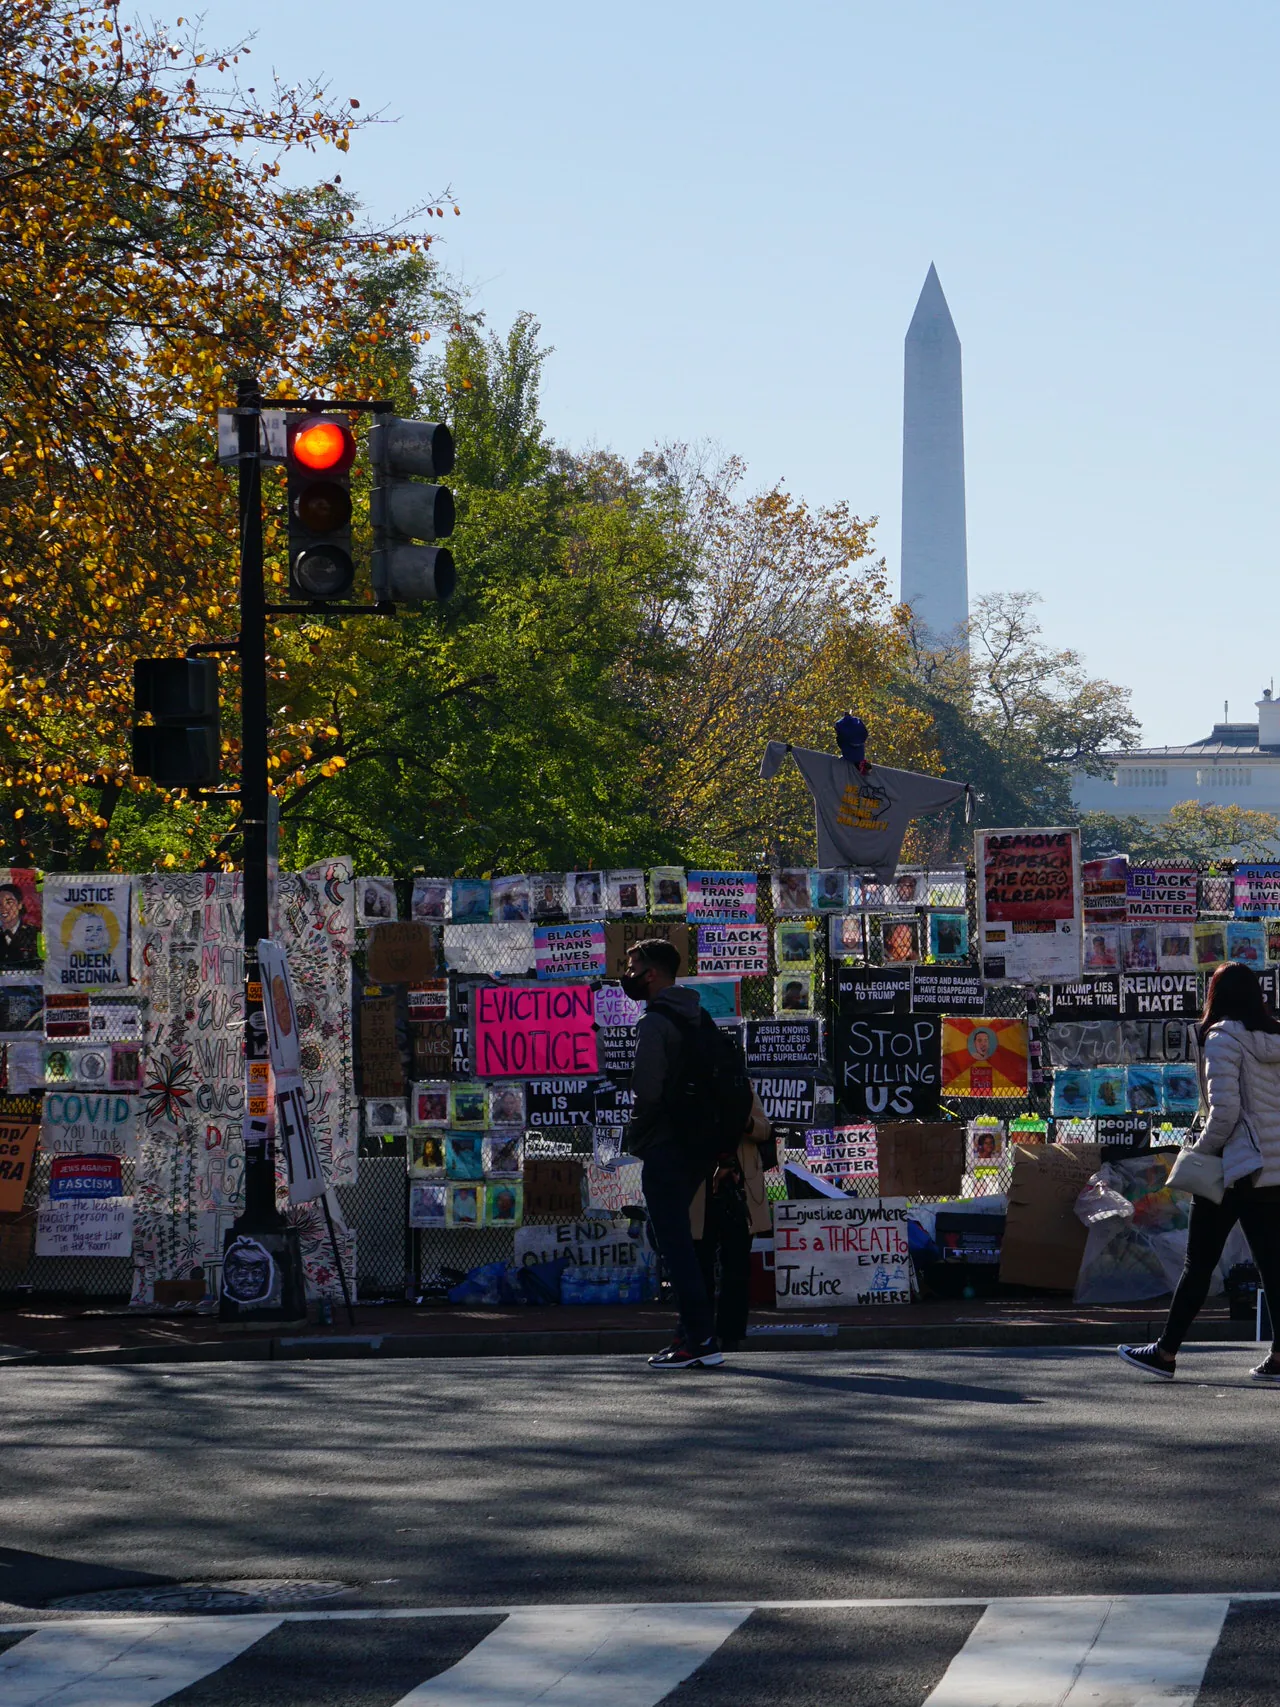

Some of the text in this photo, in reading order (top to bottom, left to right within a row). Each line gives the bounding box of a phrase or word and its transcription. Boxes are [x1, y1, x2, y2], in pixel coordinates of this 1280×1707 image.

[863, 799, 879, 809] THE
[837, 816, 889, 831] MAJORITY
[988, 833, 1066, 849] REMOVE
[702, 877, 744, 885] BLACK
[985, 871, 1068, 886] THE MOFO
[1134, 875, 1191, 887] BLACK
[64, 888, 115, 902] JUSTICE
[701, 888, 744, 896] TRANS
[1142, 890, 1186, 900] LIVES
[703, 899, 740, 907] LIVES
[696, 909, 748, 918] MATTER
[1129, 904, 1193, 915] MATTER
[548, 929, 591, 940] BLACK
[624, 926, 670, 940] BLACK
[706, 931, 761, 942] BLACK
[548, 940, 592, 951] TRANS
[713, 946, 757, 956] LIVES
[70, 953, 111, 968] QUEEN
[552, 951, 590, 962] LIVES
[546, 961, 598, 973] MATTER
[701, 959, 763, 970] MATTER
[61, 969, 121, 983] BREONNA
[915, 976, 952, 985] CHECKS AND
[840, 982, 910, 991] NO ALLEGIANCE
[937, 986, 977, 994] DISAPPEARED
[1061, 982, 1113, 994] TRUMP LIES
[1125, 976, 1196, 993] REMOVE
[867, 991, 895, 1000] TRUMP
[914, 995, 933, 1003] BEFORE
[952, 996, 966, 1004] VERY
[968, 996, 983, 1004] EYES
[1056, 994, 1118, 1005] ALL THE TIME
[480, 989, 591, 1023] EVICTION
[1138, 995, 1183, 1012] HATE
[757, 1026, 808, 1034] JESUS KNOWS
[787, 1035, 810, 1043] JESUS
[849, 1021, 934, 1056] STOP
[417, 1040, 449, 1054] LIVES
[484, 1031, 591, 1073] NOTICE
[776, 1044, 795, 1052] TOOL
[797, 1044, 806, 1052] OF
[748, 1053, 817, 1061] WHITE SUPREMACY
[844, 1061, 935, 1086] KILLING
[531, 1081, 587, 1094] TRUMP
[754, 1079, 807, 1098] TRUMP
[552, 1097, 567, 1109] IS
[865, 1086, 914, 1114] US
[47, 1095, 129, 1123] COVID
[764, 1101, 812, 1119] UNFIT
[531, 1111, 590, 1125] GUILTY
[1098, 1119, 1147, 1132] people
[62, 1126, 118, 1140] YOU had
[814, 1131, 870, 1145] BLACK
[1098, 1133, 1133, 1145] build
[53, 1141, 83, 1152] ONE
[823, 1147, 867, 1159] LIVES
[811, 1161, 873, 1174] MATTER
[59, 1179, 113, 1189] FASCISM
[93, 1200, 122, 1211] least
[74, 1213, 107, 1224] person
[778, 1200, 907, 1226] Injustice anywhere
[557, 1224, 607, 1242] END
[777, 1226, 908, 1252] Is a THREAT to
[858, 1254, 908, 1265] EVERY
[777, 1265, 843, 1296] Justice
[857, 1291, 908, 1304] WHERE
